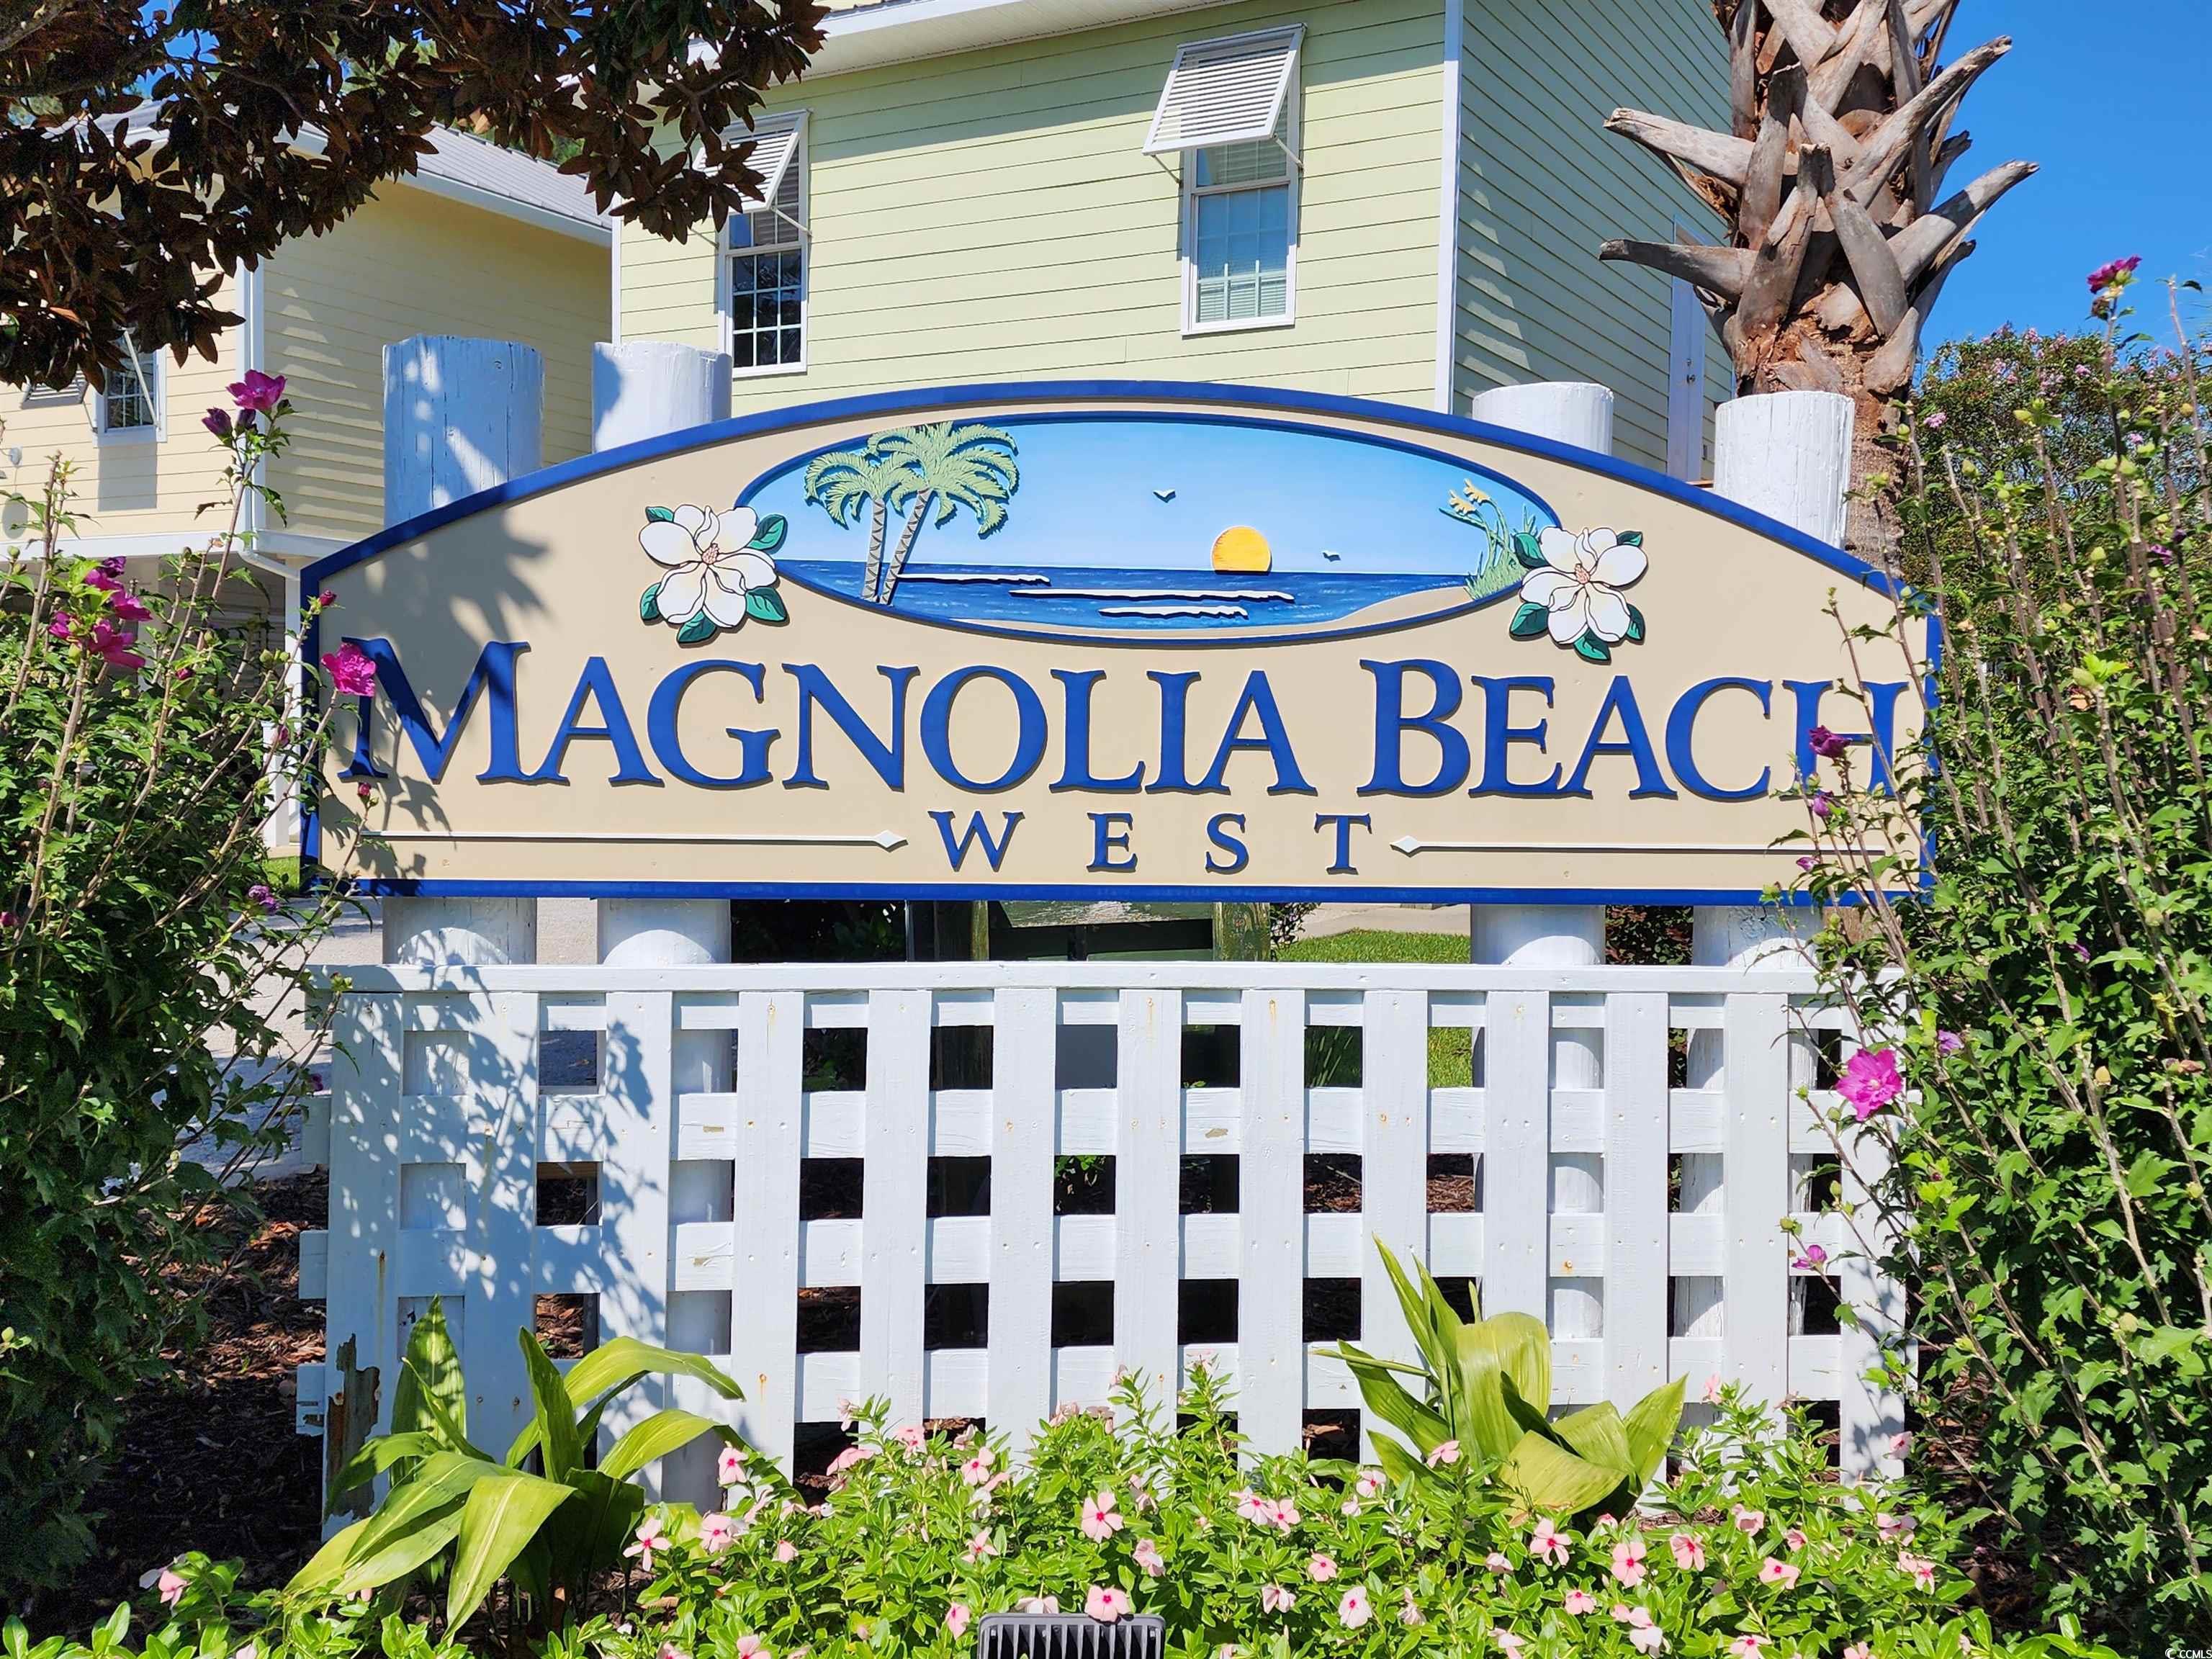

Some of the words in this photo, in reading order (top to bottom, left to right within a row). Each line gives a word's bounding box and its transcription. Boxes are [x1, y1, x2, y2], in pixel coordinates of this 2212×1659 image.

[338, 637, 1317, 795] MAGNOLIA
[1357, 659, 1908, 801] BEACH
[928, 811, 1372, 873] WEST
